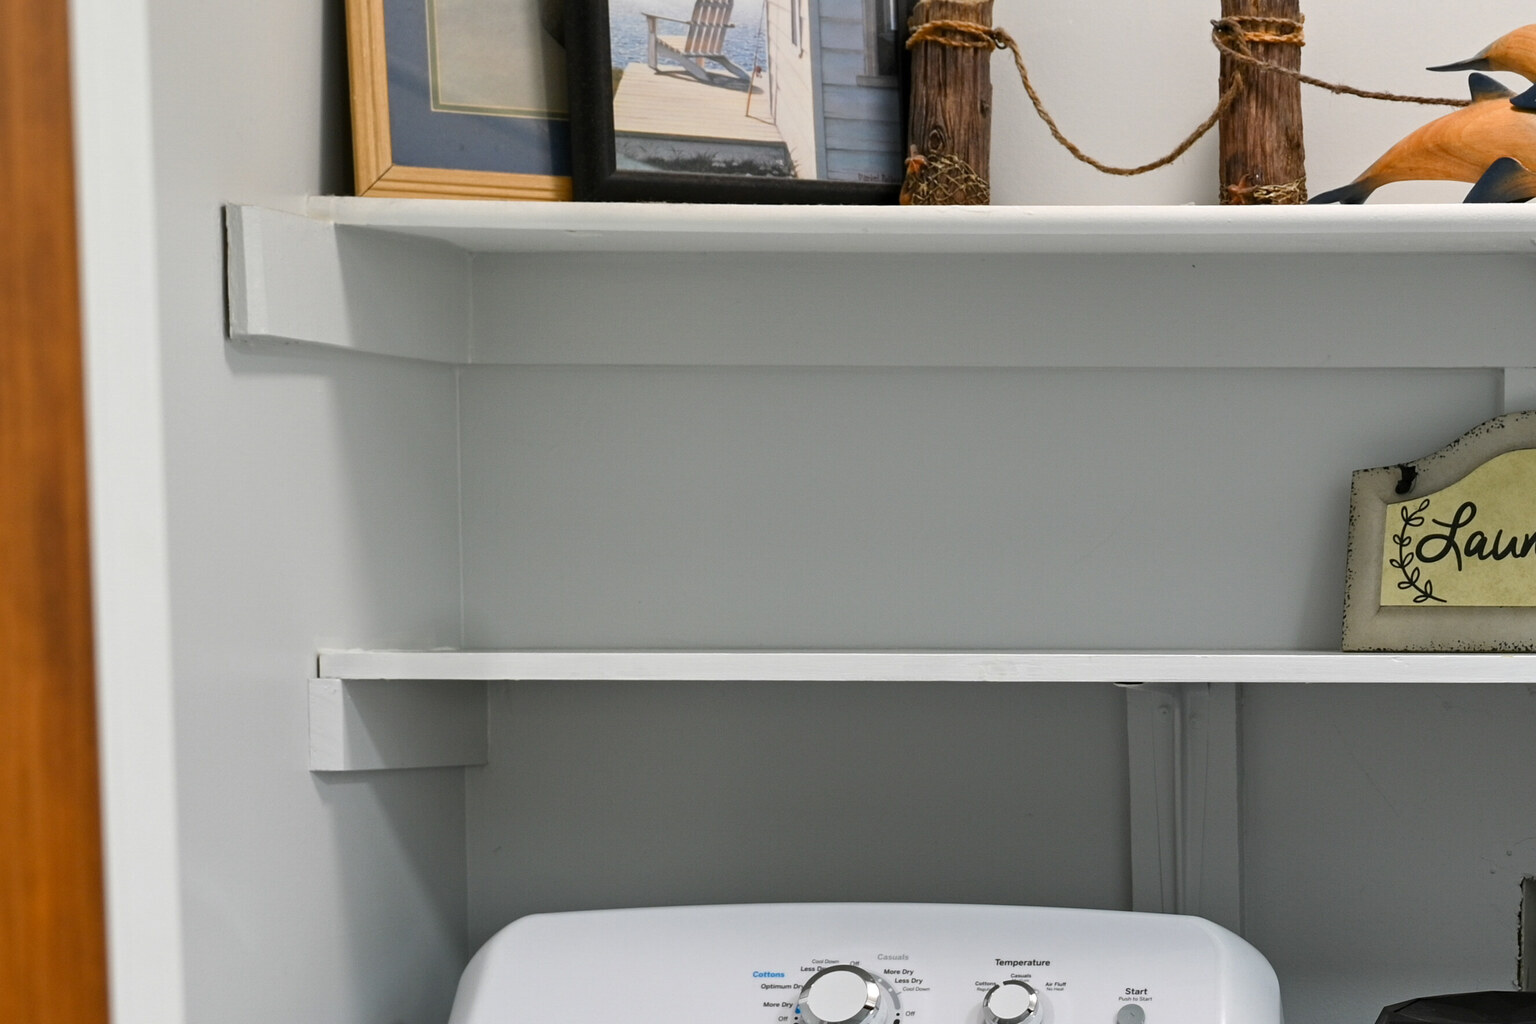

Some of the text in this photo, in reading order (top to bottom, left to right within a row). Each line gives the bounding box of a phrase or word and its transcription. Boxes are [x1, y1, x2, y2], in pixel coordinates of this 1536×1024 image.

[877, 953, 909, 961] Casuals
[995, 958, 1051, 967] Temperature
[752, 970, 785, 978] Cottons
[901, 968, 914, 976] Dry
[911, 977, 923, 985] Dry
[1125, 987, 1149, 995] Start
[781, 1001, 794, 1009] Dry
